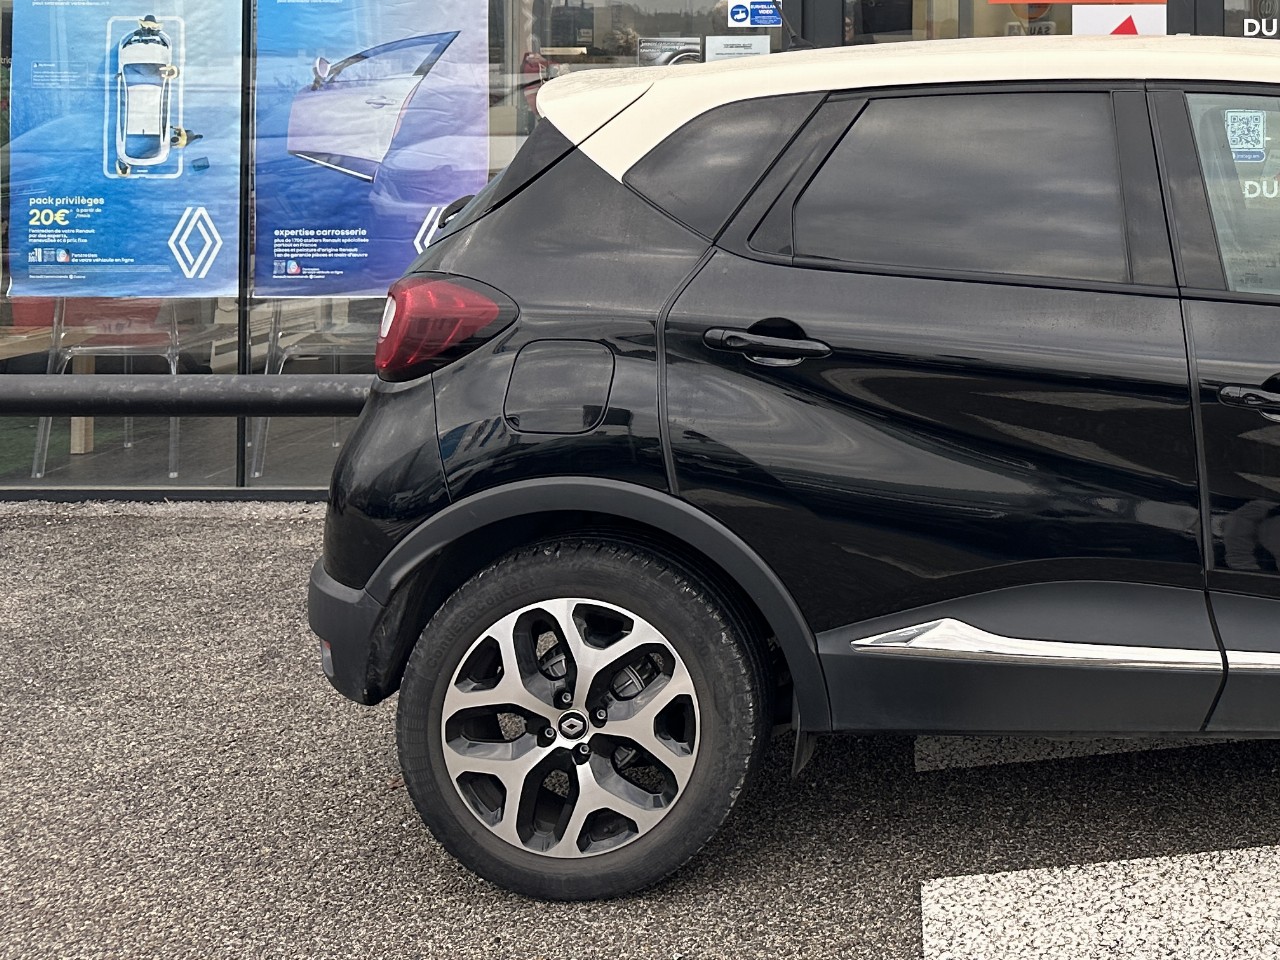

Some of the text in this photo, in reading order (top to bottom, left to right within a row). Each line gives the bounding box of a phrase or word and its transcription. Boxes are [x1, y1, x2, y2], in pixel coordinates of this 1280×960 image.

[1243, 17, 1278, 36] DU
[1243, 179, 1278, 198] DU
[29, 196, 105, 207] pack privilèges
[274, 228, 367, 237] expertise carrosserie
